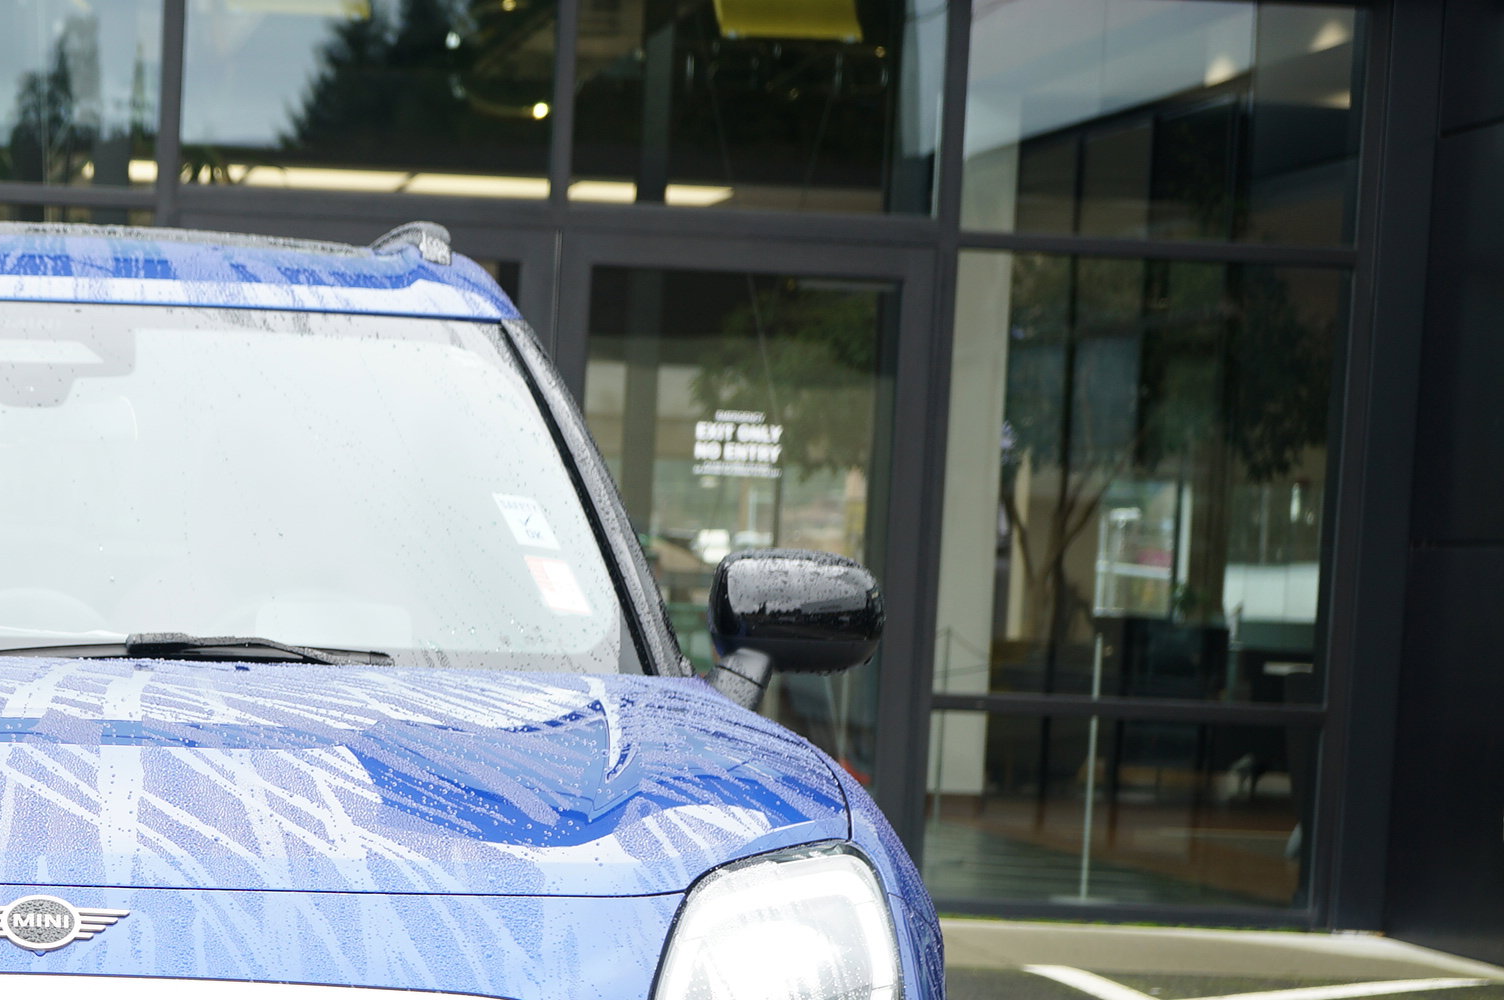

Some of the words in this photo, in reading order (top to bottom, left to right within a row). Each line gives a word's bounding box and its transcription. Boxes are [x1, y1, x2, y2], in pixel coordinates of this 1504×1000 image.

[695, 421, 736, 441] EXIT
[737, 423, 783, 443] ONLY
[694, 440, 722, 460] NO
[723, 442, 782, 463] ENTRY
[13, 913, 70, 929] MINI
